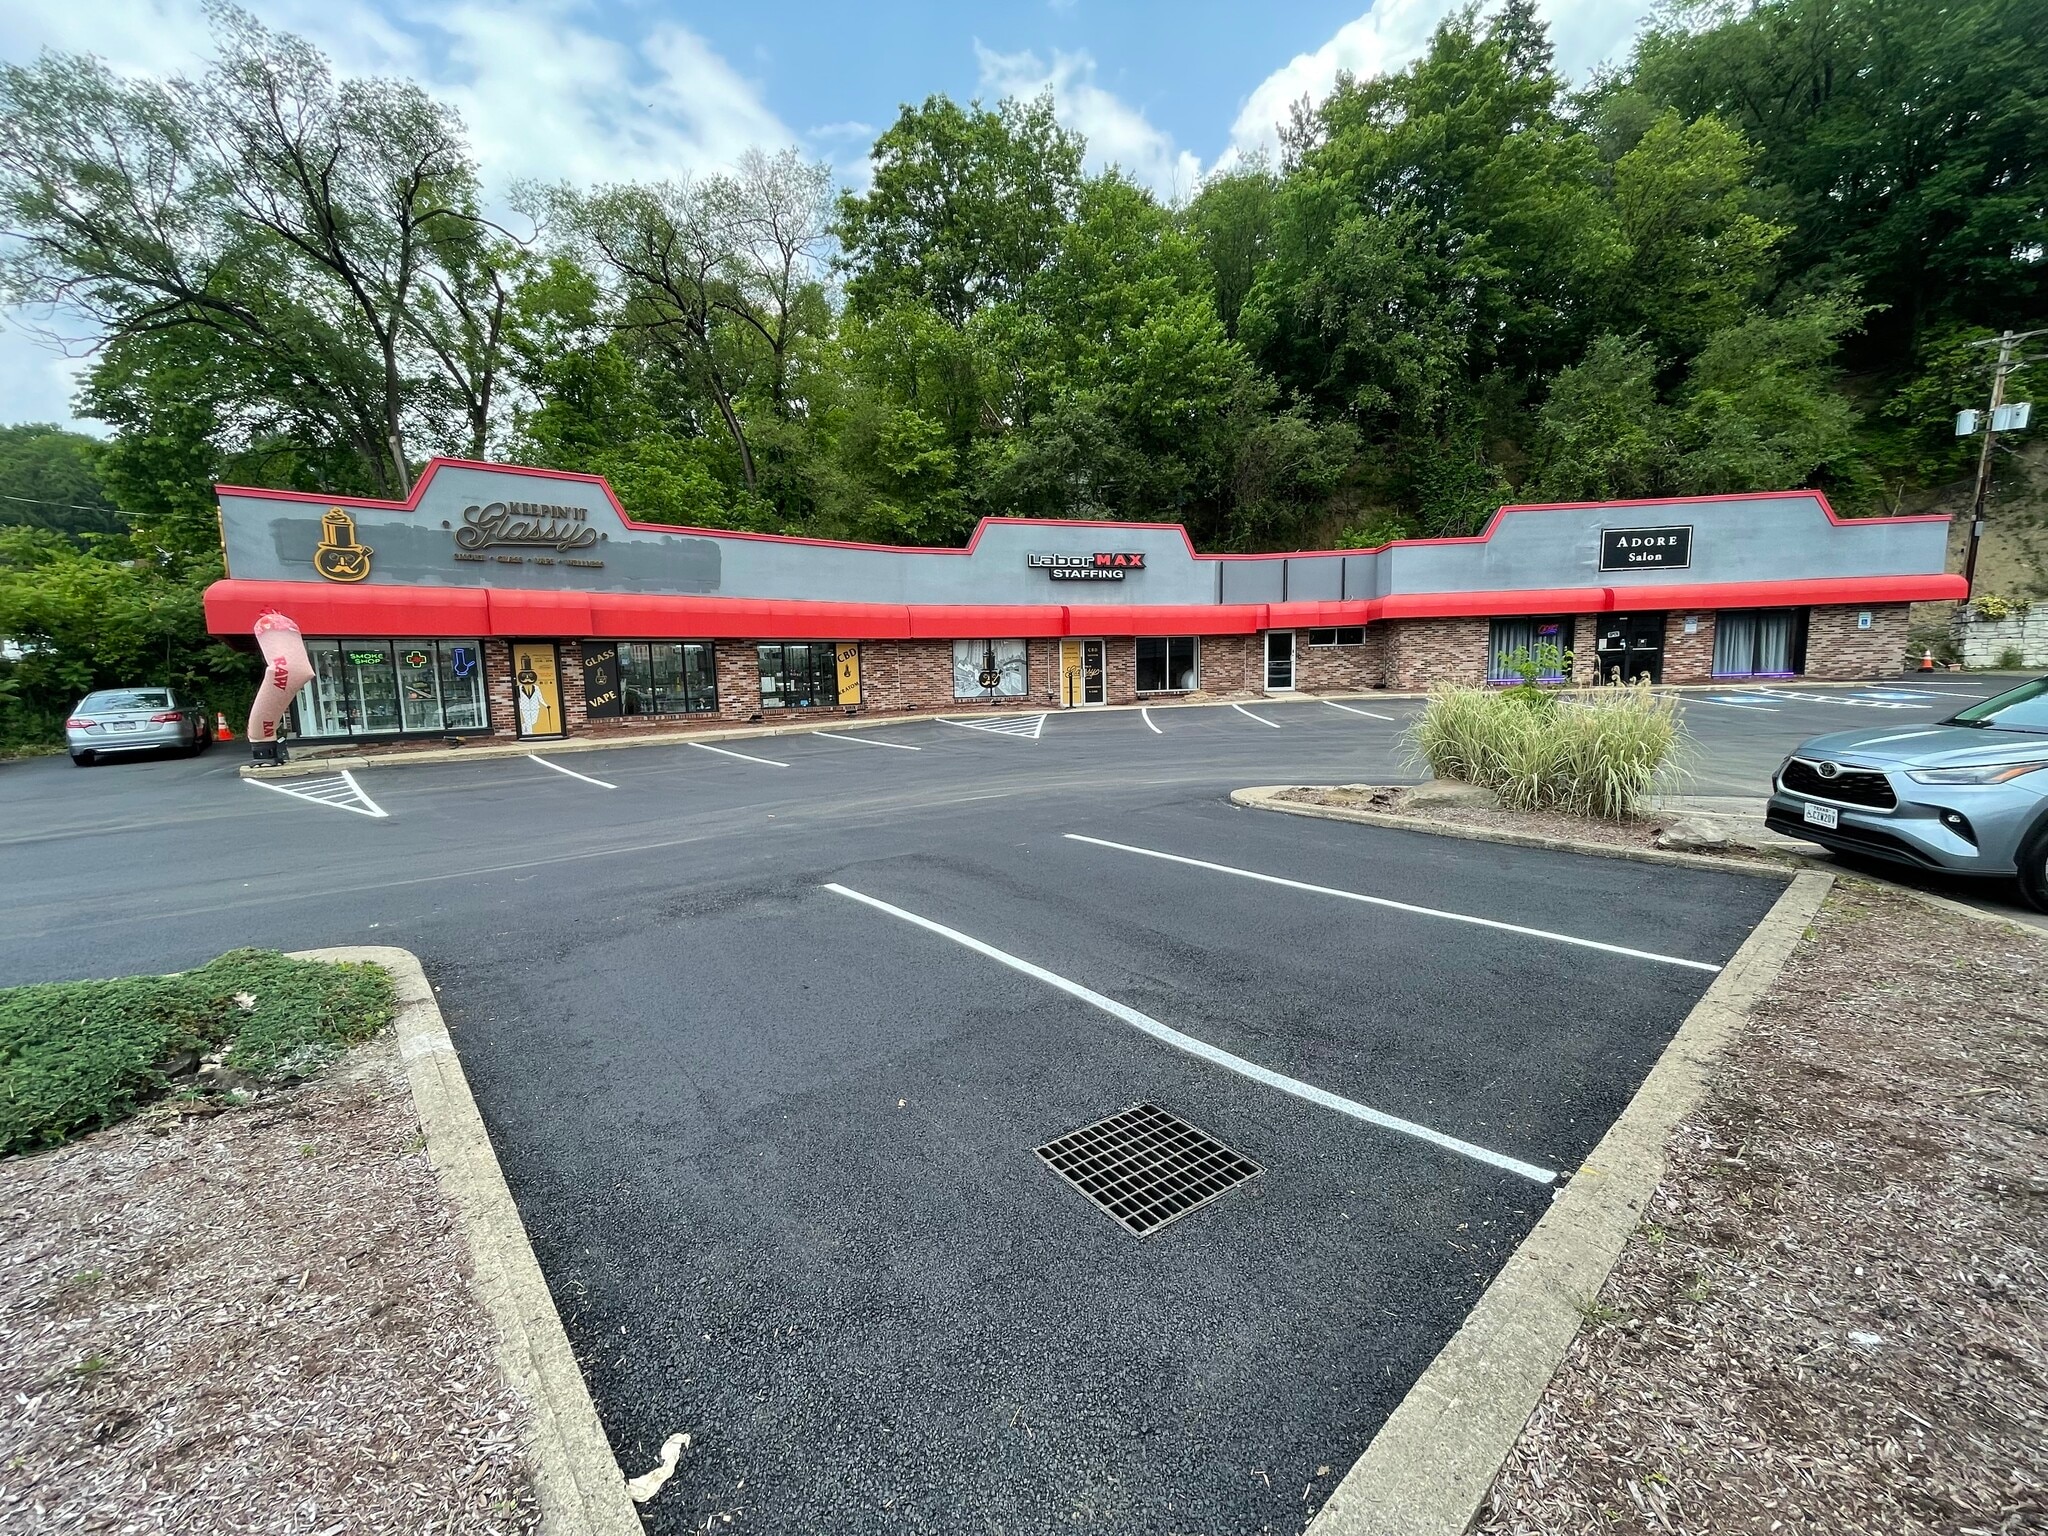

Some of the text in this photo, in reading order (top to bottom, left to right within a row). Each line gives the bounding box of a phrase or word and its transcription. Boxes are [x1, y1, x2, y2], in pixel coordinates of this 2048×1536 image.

[508, 501, 588, 521] KEEPIN' IT
[454, 502, 597, 553] Glassy
[1616, 535, 1678, 548] ADORE
[1628, 552, 1662, 562] Salon
[1053, 569, 1124, 578] STAFFING
[585, 649, 615, 667] GLASS
[837, 648, 856, 663] CBD
[273, 656, 288, 691] RAW
[588, 690, 617, 708] VAPE
[1813, 805, 1829, 813] TEXAS
